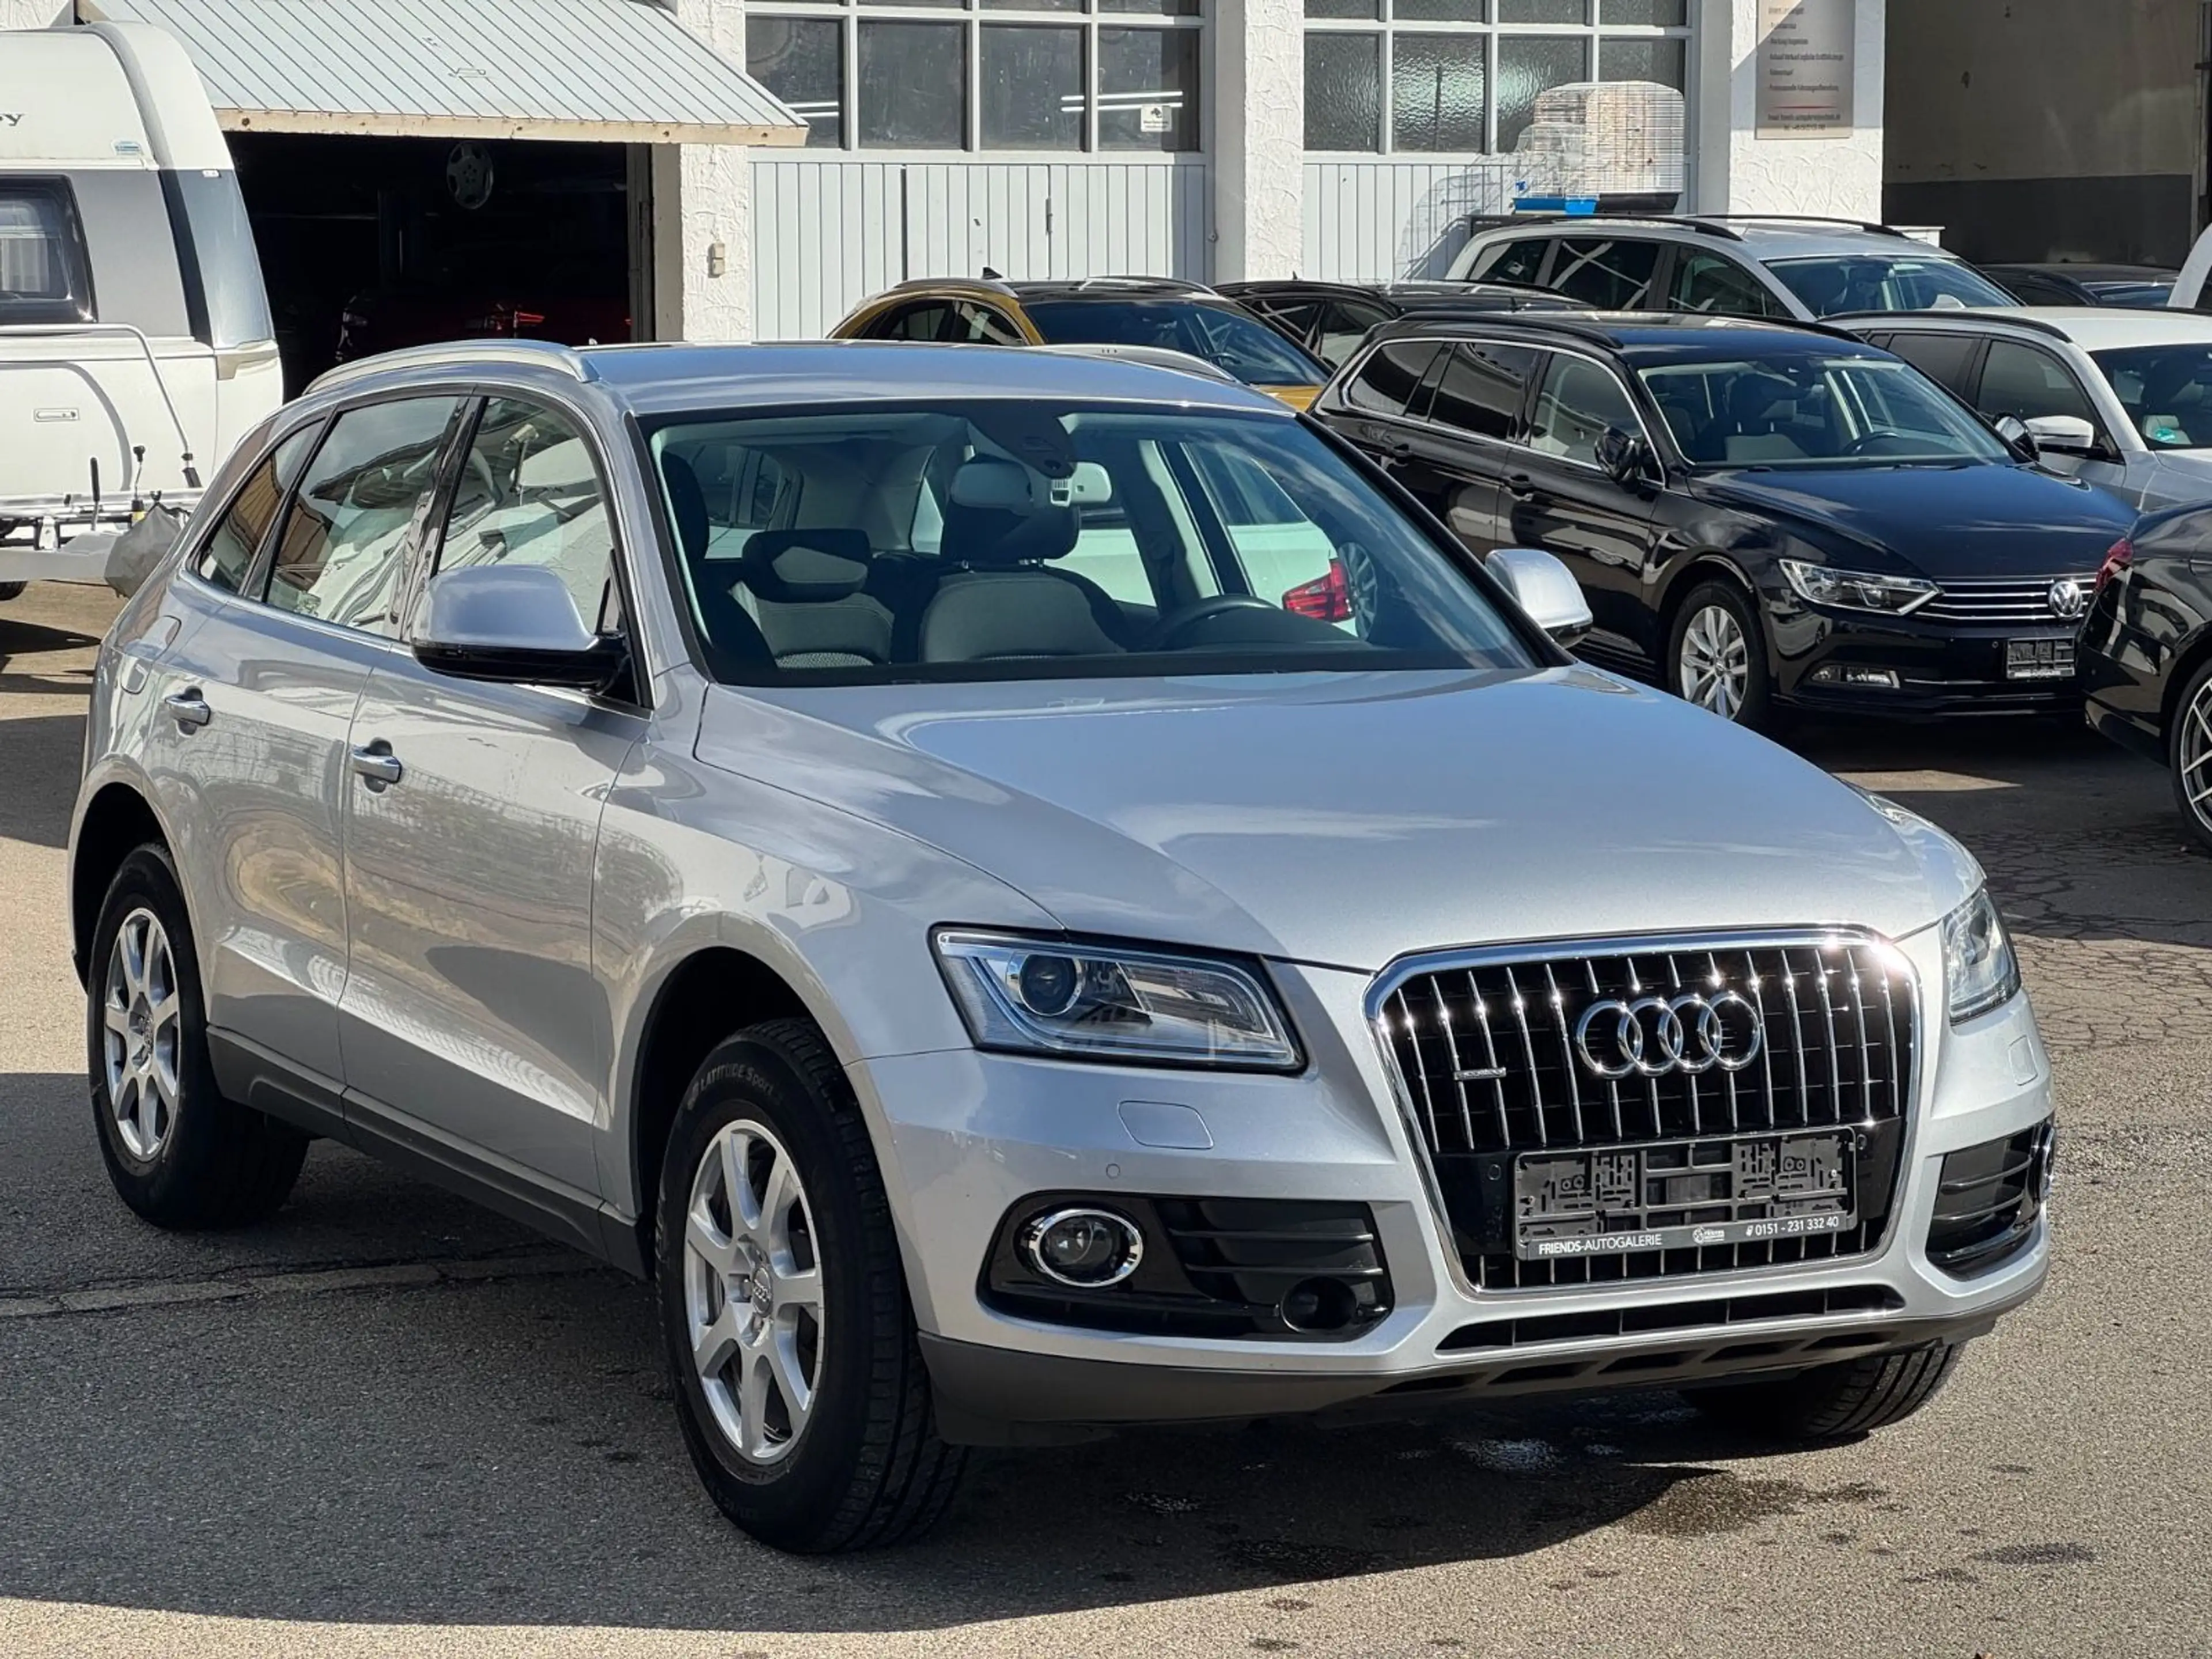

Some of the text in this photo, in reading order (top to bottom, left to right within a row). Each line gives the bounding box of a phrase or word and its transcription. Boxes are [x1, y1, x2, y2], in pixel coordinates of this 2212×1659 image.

[1755, 1223, 1778, 1236] 0151
[1787, 1219, 1804, 1232] 231
[1806, 1219, 1824, 1230] 332
[1826, 1216, 1839, 1228] 40
[1539, 1234, 1663, 1255] FRIENDS-AUTOGALERIE
